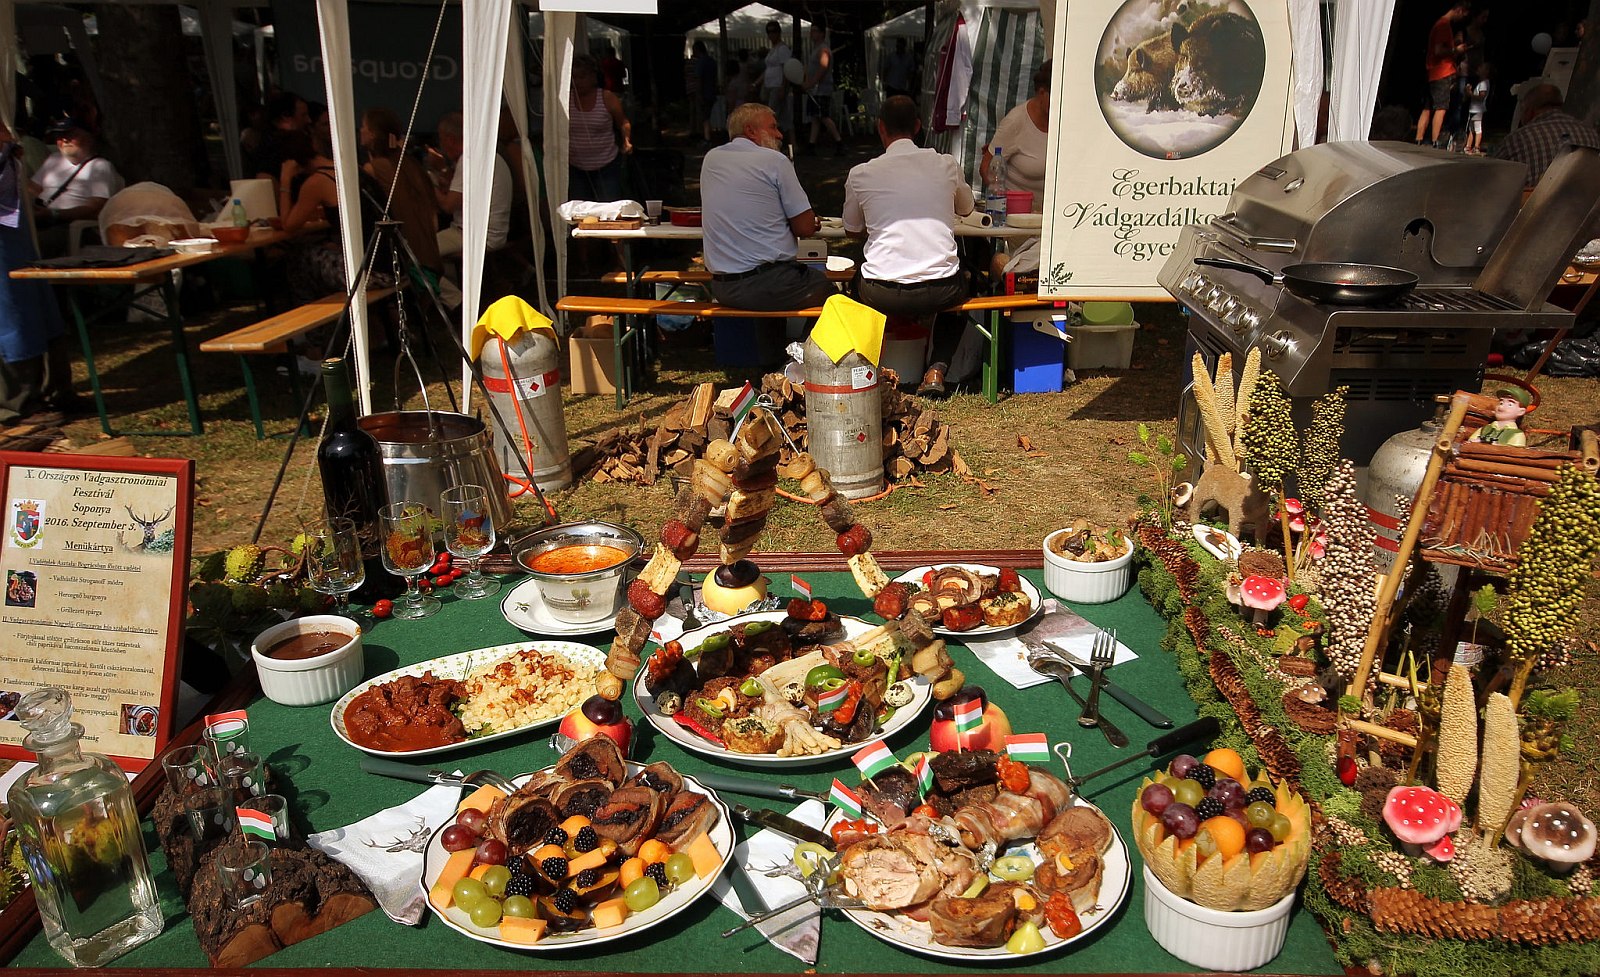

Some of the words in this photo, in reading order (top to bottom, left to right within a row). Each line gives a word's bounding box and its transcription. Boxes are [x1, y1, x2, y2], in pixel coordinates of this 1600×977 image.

[1112, 169, 1236, 200] Egerbaktai
[1063, 203, 1217, 231] Vadgazdálko
[1113, 227, 1178, 261] Egyes
[25, 469, 35, 479] X.
[38, 471, 81, 483] Országos
[84, 473, 168, 487] Vadgasztronómiai
[73, 487, 115, 499] Fesztivál
[72, 503, 112, 515] Soponya
[45, 517, 69, 527] 2016.
[71, 518, 126, 531] Szeptember
[128, 523, 137, 531] 3.
[65, 541, 114, 553] Menükártya
